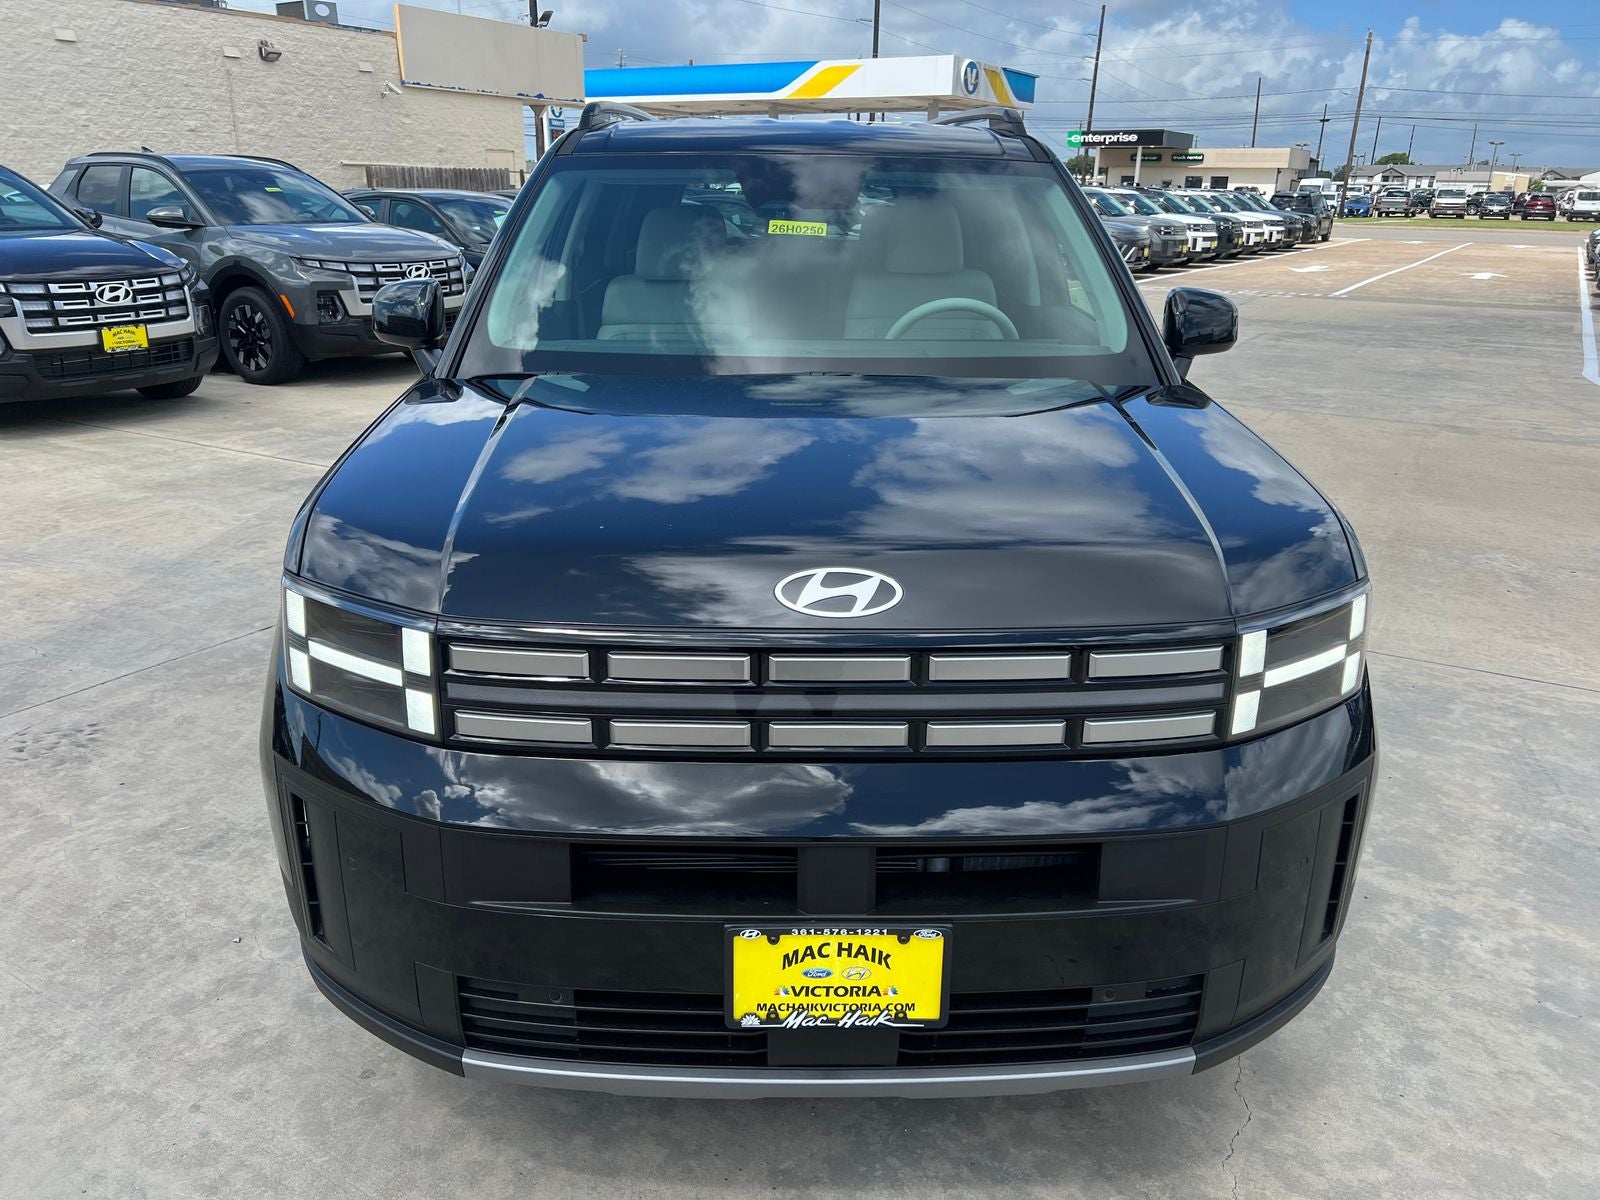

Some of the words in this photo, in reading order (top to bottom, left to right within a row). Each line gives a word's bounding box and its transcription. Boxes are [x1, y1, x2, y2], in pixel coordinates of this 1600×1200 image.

[1070, 132, 1138, 144] enterprise
[770, 224, 824, 235] 26H0250
[791, 928, 888, 936] 361-576-1221
[782, 942, 830, 970] MAC
[837, 942, 892, 970] HAIK
[806, 969, 829, 978] Ford
[791, 985, 882, 998] VICTORIA
[756, 1003, 916, 1012] MACHAIKVICTORIACOM
[782, 1010, 837, 1029] Mac
[836, 1009, 896, 1029] Haik
